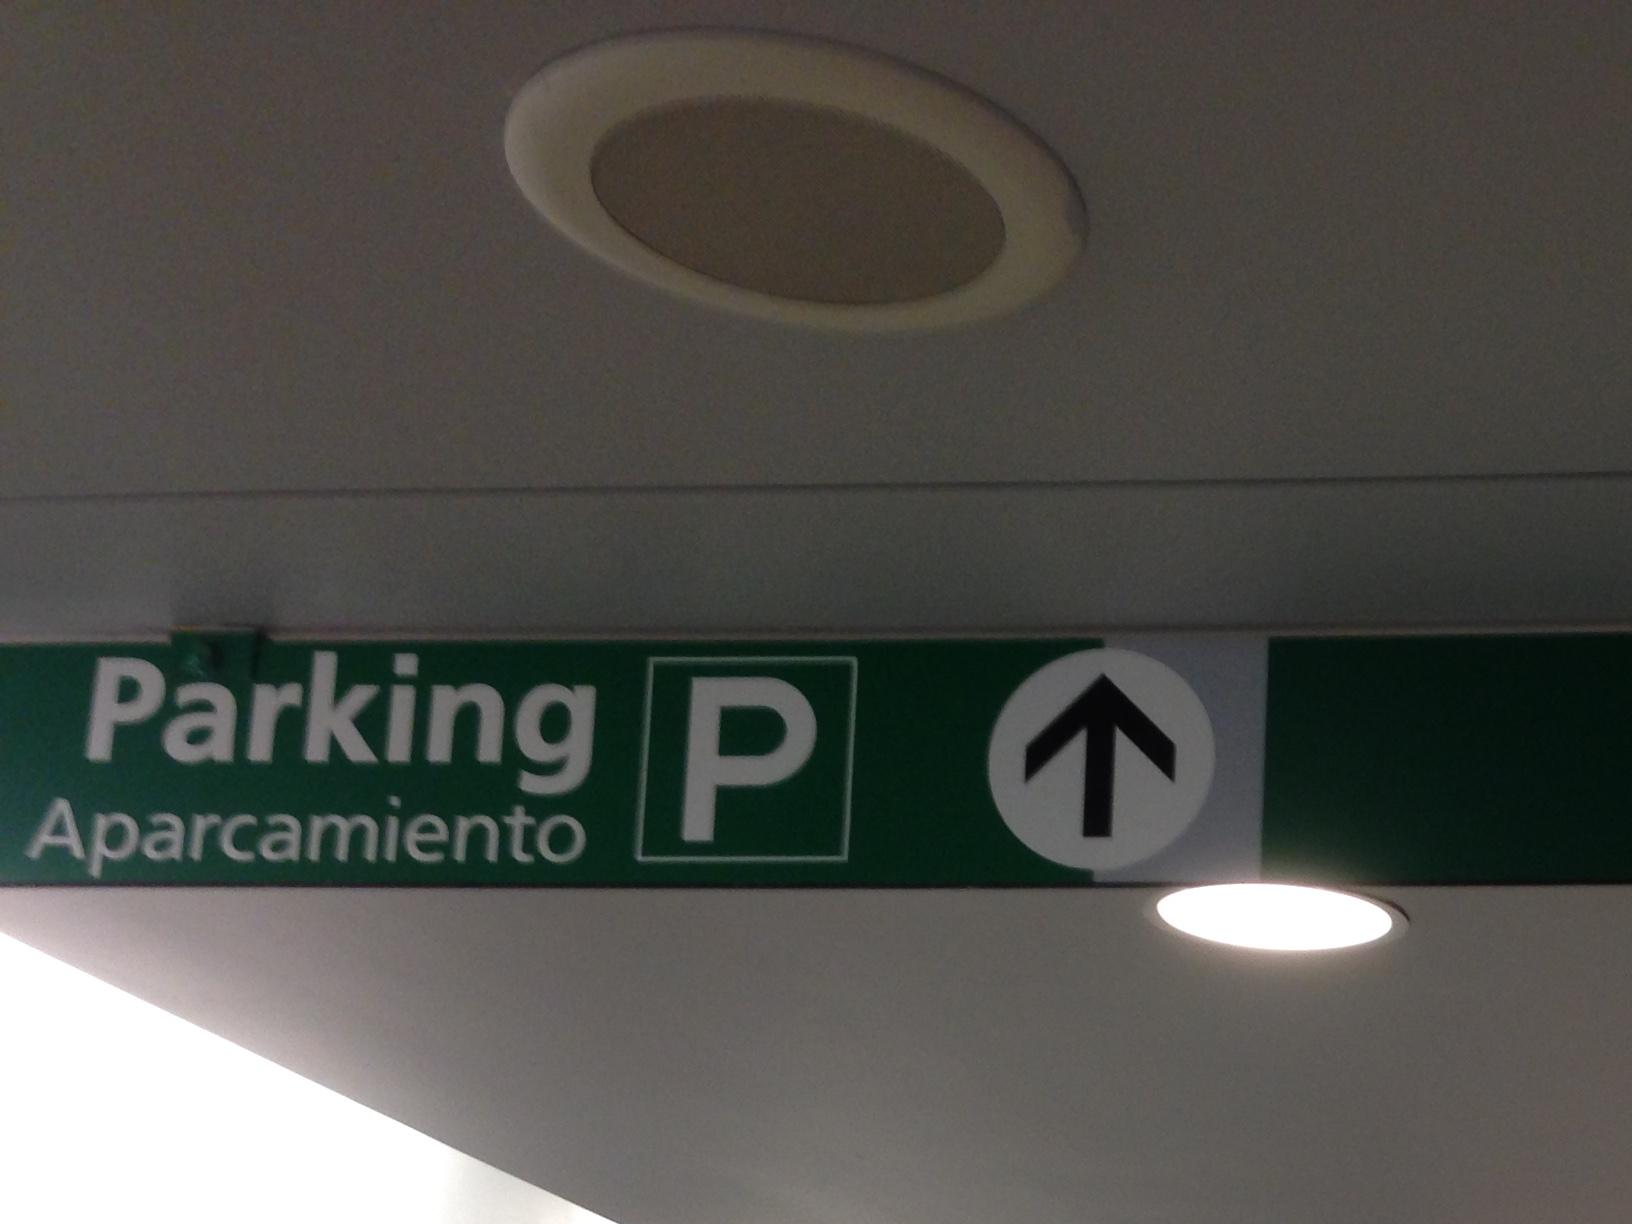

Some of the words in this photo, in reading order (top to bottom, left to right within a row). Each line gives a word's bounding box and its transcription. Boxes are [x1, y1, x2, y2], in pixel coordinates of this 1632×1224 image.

[85, 650, 598, 796] Parking
[682, 676, 818, 843] P
[25, 796, 588, 879] Aparcamiento
